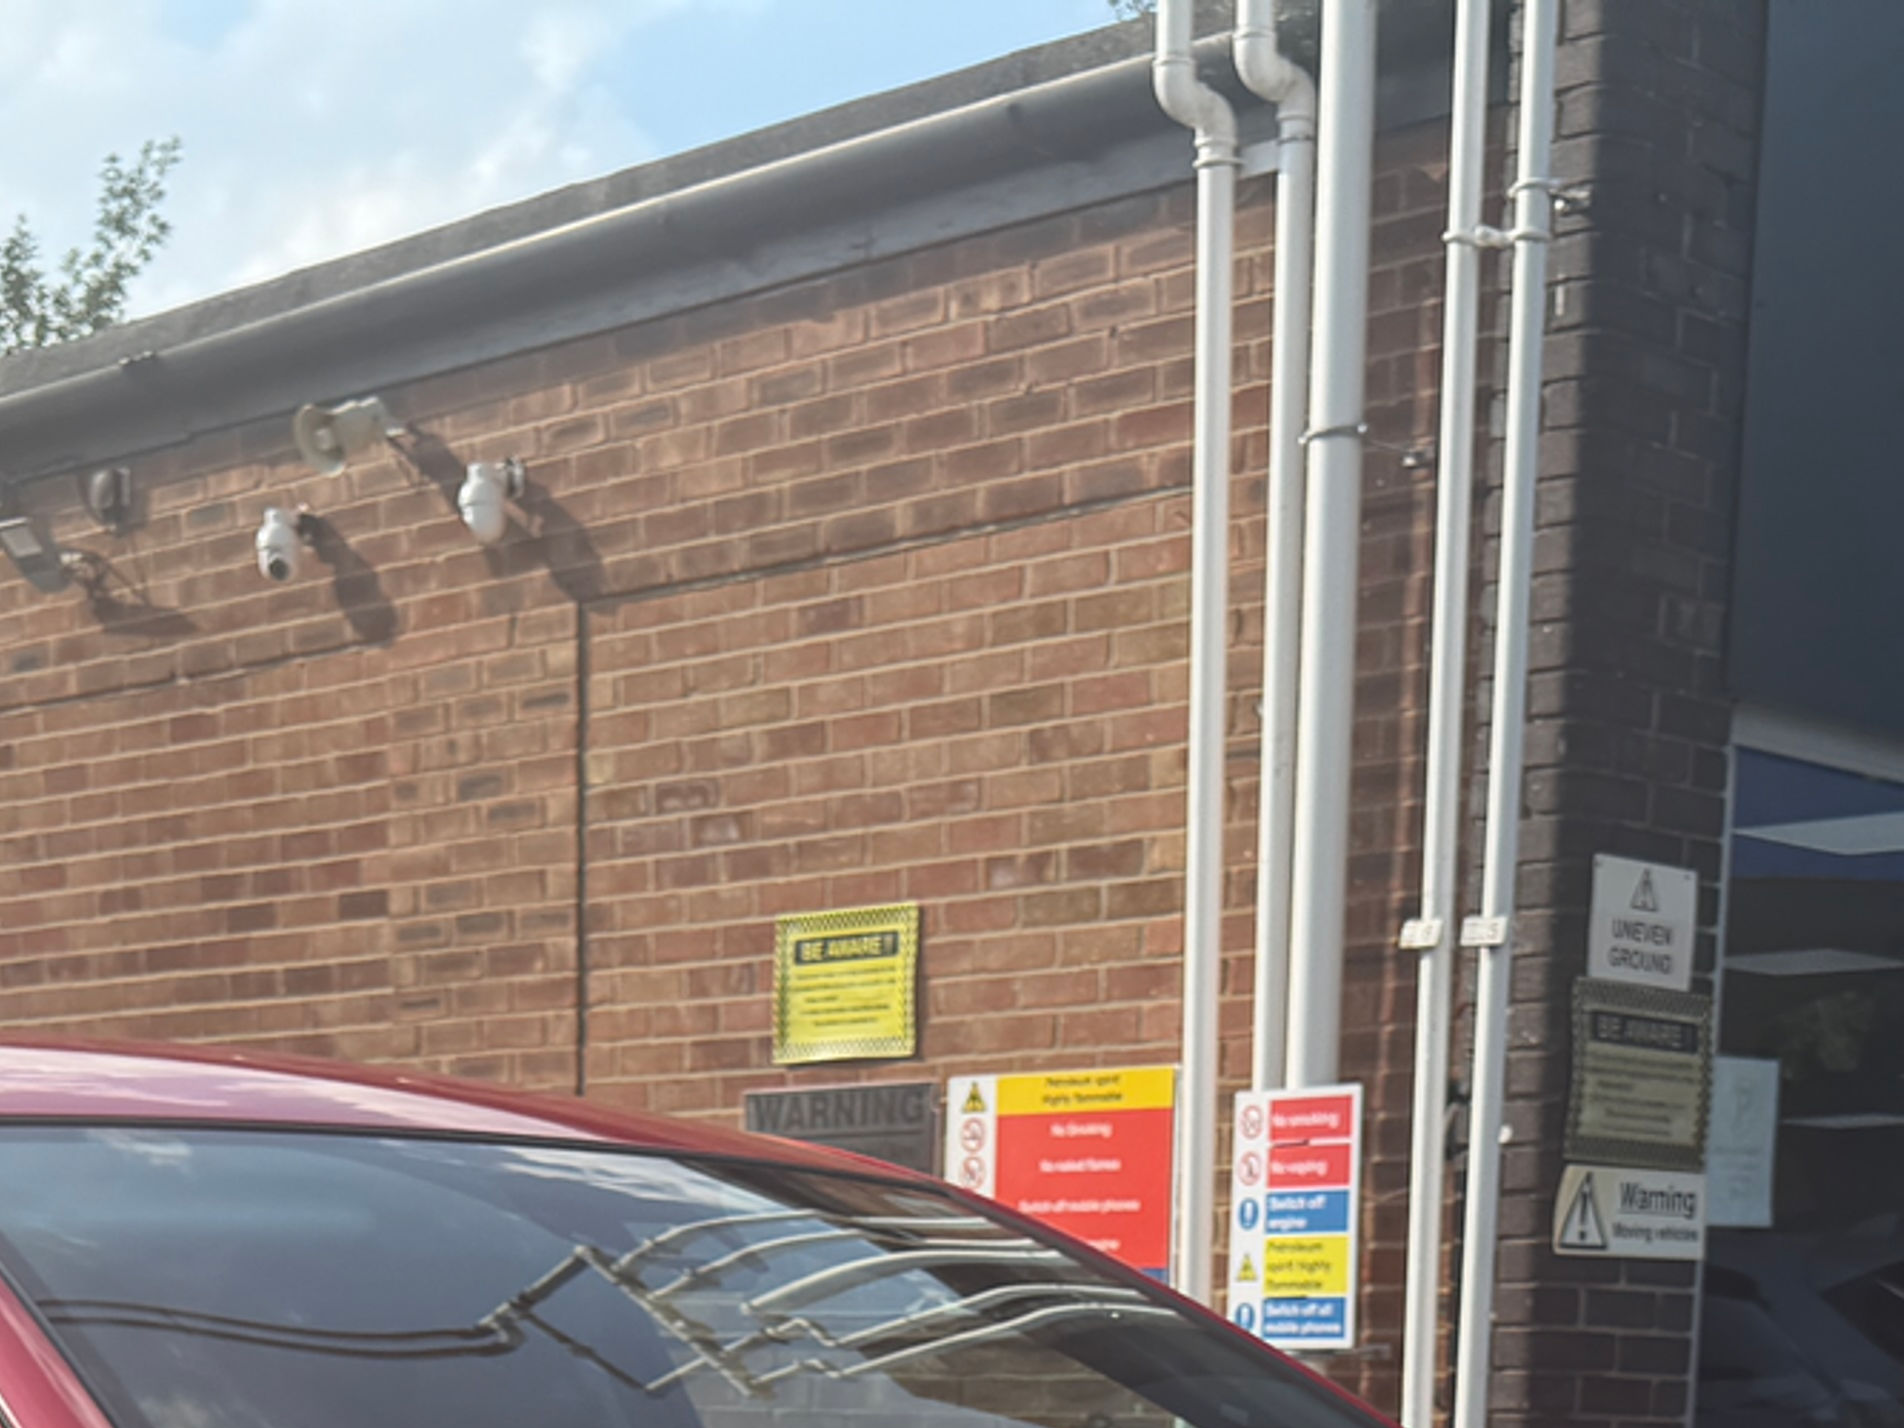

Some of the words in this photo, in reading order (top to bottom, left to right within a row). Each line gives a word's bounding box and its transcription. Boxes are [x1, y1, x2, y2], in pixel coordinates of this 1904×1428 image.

[1611, 918, 1673, 946] UNEVEN
[801, 941, 824, 961] BE
[828, 936, 883, 958] AWARE
[1607, 945, 1673, 976] GROUND
[1598, 1015, 1624, 1041] BE
[1626, 1019, 1682, 1048] AWARE
[755, 1088, 925, 1132] WARNING
[1272, 1113, 1287, 1127] No
[1271, 1161, 1286, 1175] No
[1269, 1196, 1305, 1211] Switch
[1307, 1194, 1327, 1210] off
[1619, 1182, 1696, 1219] Warning
[1268, 1217, 1307, 1231] engine
[1612, 1222, 1651, 1243] Moving
[1654, 1225, 1699, 1243] vehicles
[1266, 1303, 1299, 1317] Switch
[1265, 1321, 1299, 1334] mobile
[1300, 1321, 1342, 1336] phones
